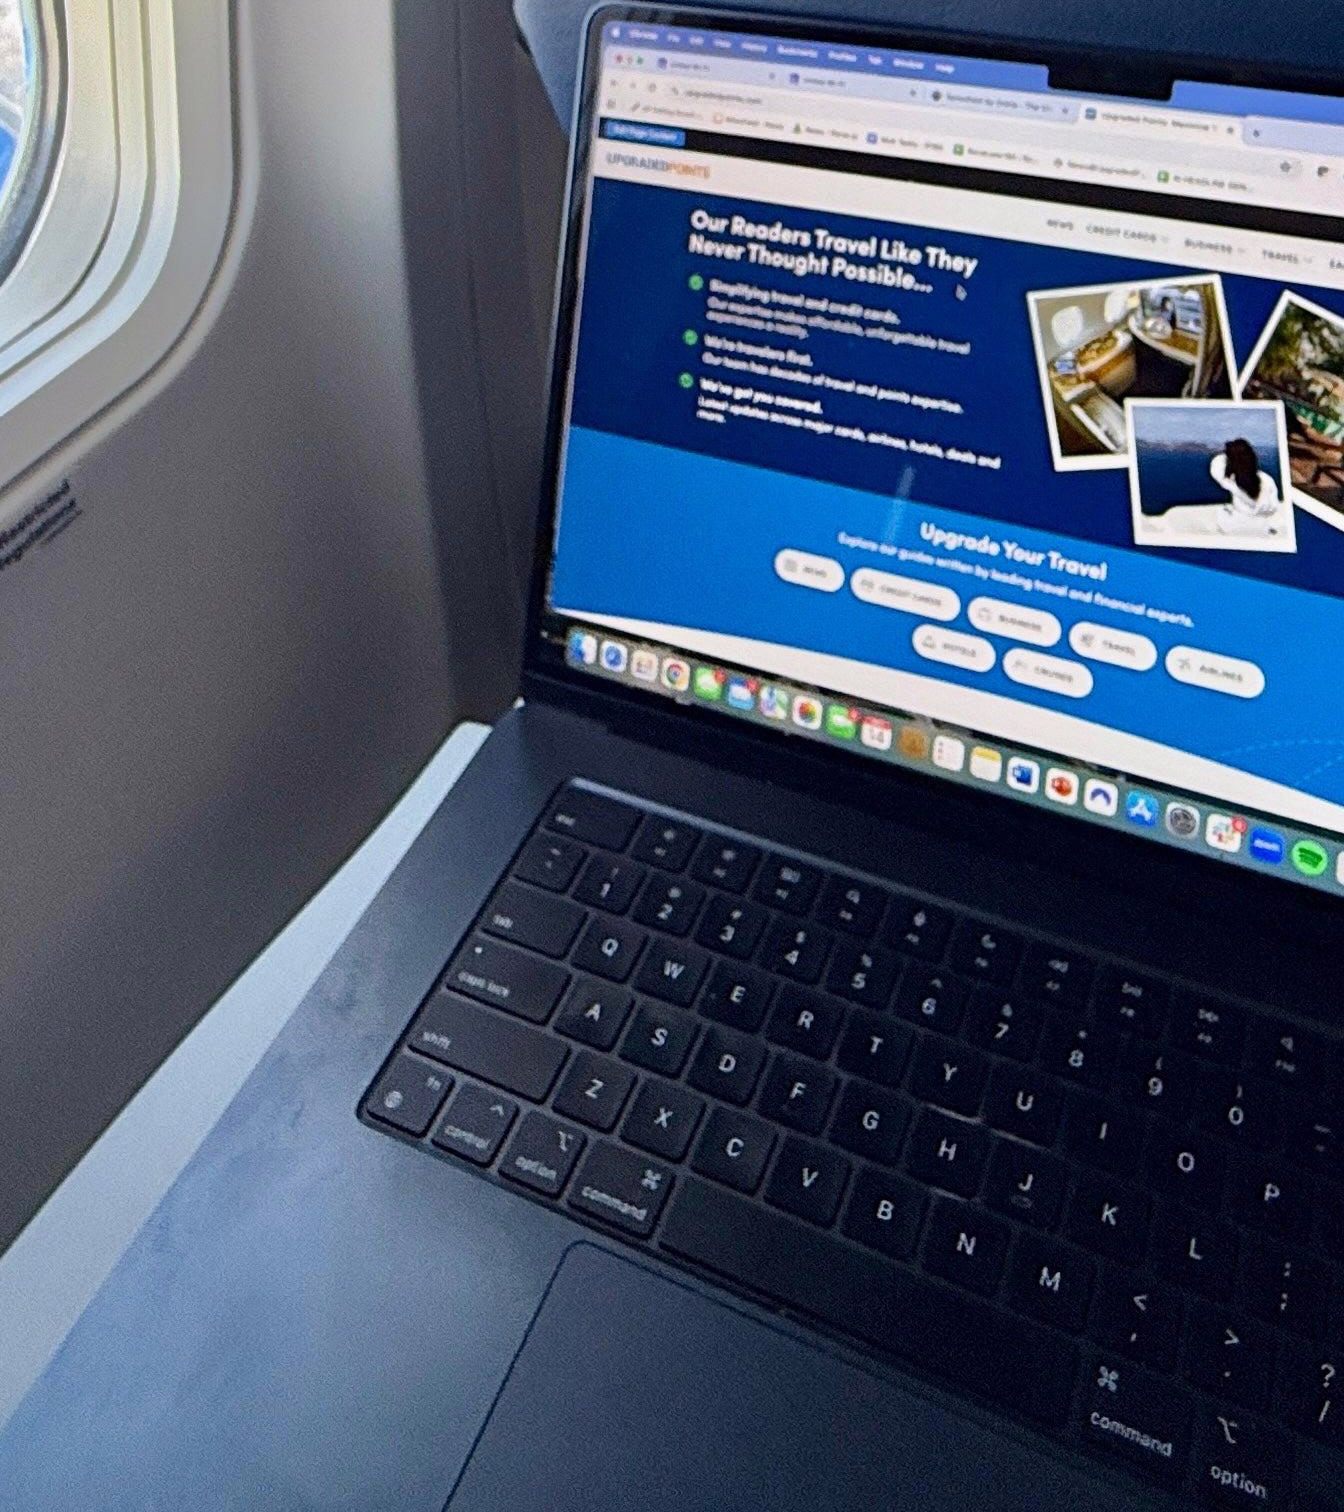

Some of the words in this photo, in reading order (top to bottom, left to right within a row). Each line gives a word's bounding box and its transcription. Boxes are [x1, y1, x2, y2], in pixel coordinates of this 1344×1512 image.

[691, 210, 729, 232] Our
[731, 216, 811, 247] Readers
[815, 229, 877, 257] Travel
[880, 240, 922, 264] Like
[926, 246, 977, 278] They
[689, 234, 745, 260] Never
[747, 243, 829, 276] Thought
[832, 257, 932, 292] Possible...
[919, 521, 1001, 557] Upgrade
[1002, 541, 1046, 569] Your
[1047, 549, 1108, 581] Travel
[601, 883, 610, 897] 1
[658, 904, 672, 919] 2
[721, 926, 734, 941] 3
[602, 939, 618, 956] Q
[785, 951, 799, 964] 4
[664, 961, 684, 978] W
[852, 973, 865, 989] 5
[731, 986, 745, 1002] E
[586, 1004, 600, 1020] A
[922, 998, 936, 1014] 6
[798, 1011, 814, 1028] R
[652, 1028, 667, 1045] S
[996, 1023, 1008, 1038] 7
[871, 1037, 882, 1053] T
[719, 1054, 736, 1072] D
[1069, 1050, 1083, 1067] 8
[944, 1064, 957, 1081] Y
[585, 1079, 603, 1098] Z
[791, 1082, 805, 1098] F
[1149, 1077, 1162, 1095] 9
[1017, 1092, 1033, 1111] U
[655, 1108, 672, 1127] X
[863, 1111, 879, 1130] G
[1229, 1107, 1243, 1125] 0
[444, 1125, 491, 1151] control
[1100, 1123, 1107, 1139] I
[727, 1138, 743, 1157] C
[939, 1140, 956, 1160] H
[515, 1156, 557, 1181] option
[1178, 1152, 1194, 1172] O
[803, 1168, 818, 1187] V
[1019, 1174, 1033, 1191] J
[1265, 1184, 1280, 1201] P
[582, 1185, 648, 1221] command
[877, 1200, 893, 1220] B
[1102, 1204, 1117, 1225] K
[957, 1233, 975, 1254] N
[1189, 1238, 1201, 1259] L
[1040, 1267, 1060, 1290] M
[1091, 1412, 1172, 1457] command
[1211, 1466, 1266, 1498] option
